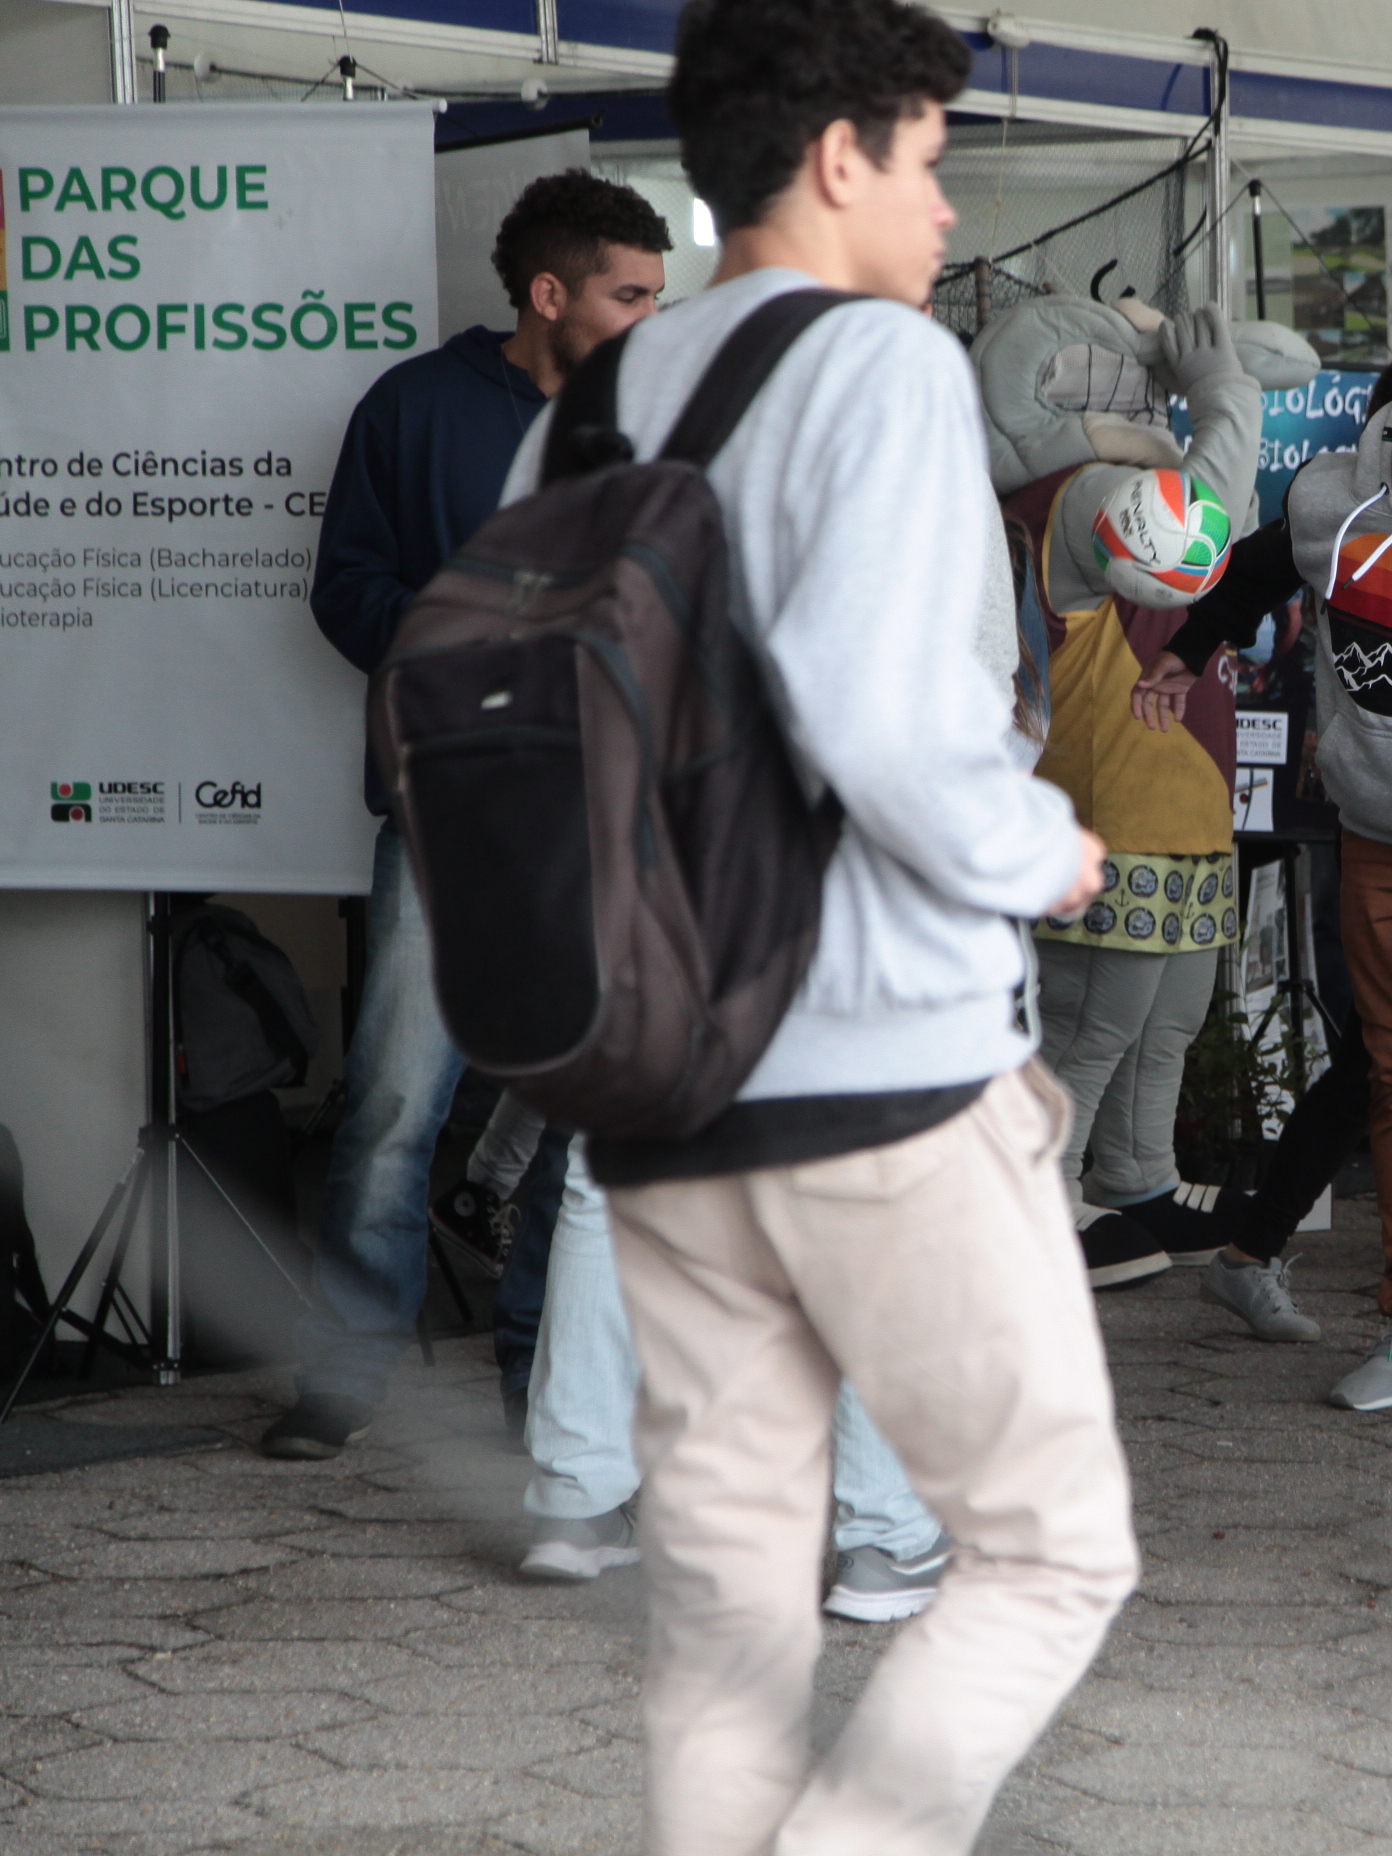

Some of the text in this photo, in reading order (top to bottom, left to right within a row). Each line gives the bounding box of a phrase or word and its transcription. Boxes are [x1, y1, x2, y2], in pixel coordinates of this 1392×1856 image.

[18, 165, 269, 220] PARQUE
[21, 235, 141, 281] DAS
[23, 289, 418, 351] PROFISSÕES
[0, 450, 292, 477] ntro de Ciências da
[60, 497, 77, 517] e
[85, 490, 122, 517] do
[132, 491, 253, 523] Esporte
[83, 547, 142, 568] Física
[150, 547, 311, 573] (Bacharelado)
[83, 577, 142, 598] Física
[151, 577, 308, 602] (Licenciatura)
[1, 607, 93, 632] ioterapia
[99, 782, 165, 795] UDESC
[195, 781, 261, 808] Cefid
